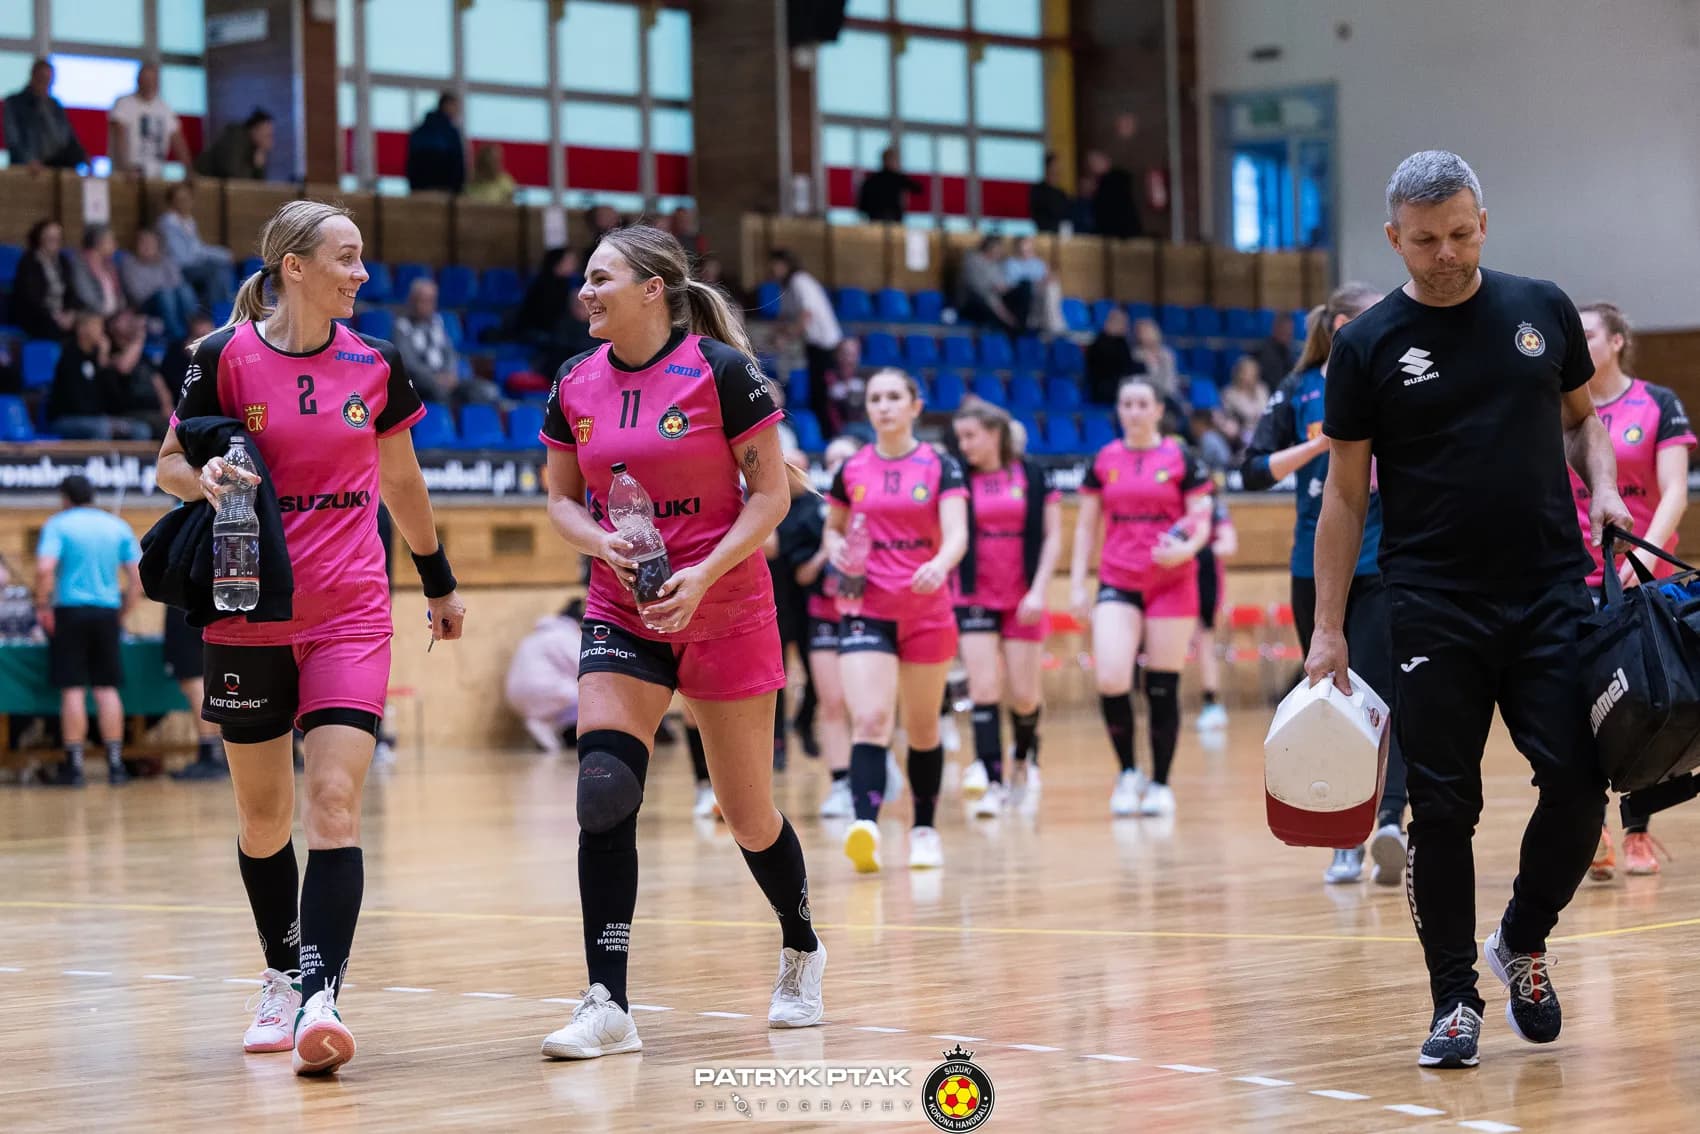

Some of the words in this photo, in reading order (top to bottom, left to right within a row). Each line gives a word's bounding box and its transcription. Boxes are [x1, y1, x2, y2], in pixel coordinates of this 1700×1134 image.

[335, 351, 375, 364] Joma
[664, 363, 702, 378] Joma
[1403, 371, 1440, 386] SUZUKI
[297, 375, 318, 415] 2
[748, 384, 768, 402] PRO
[619, 389, 642, 429] 11
[247, 415, 263, 431] CK
[884, 470, 900, 494] 13
[278, 491, 371, 513] SUZUKI
[592, 496, 700, 523] SUKI
[209, 695, 261, 709] karabela
[1589, 667, 1629, 738] ummel
